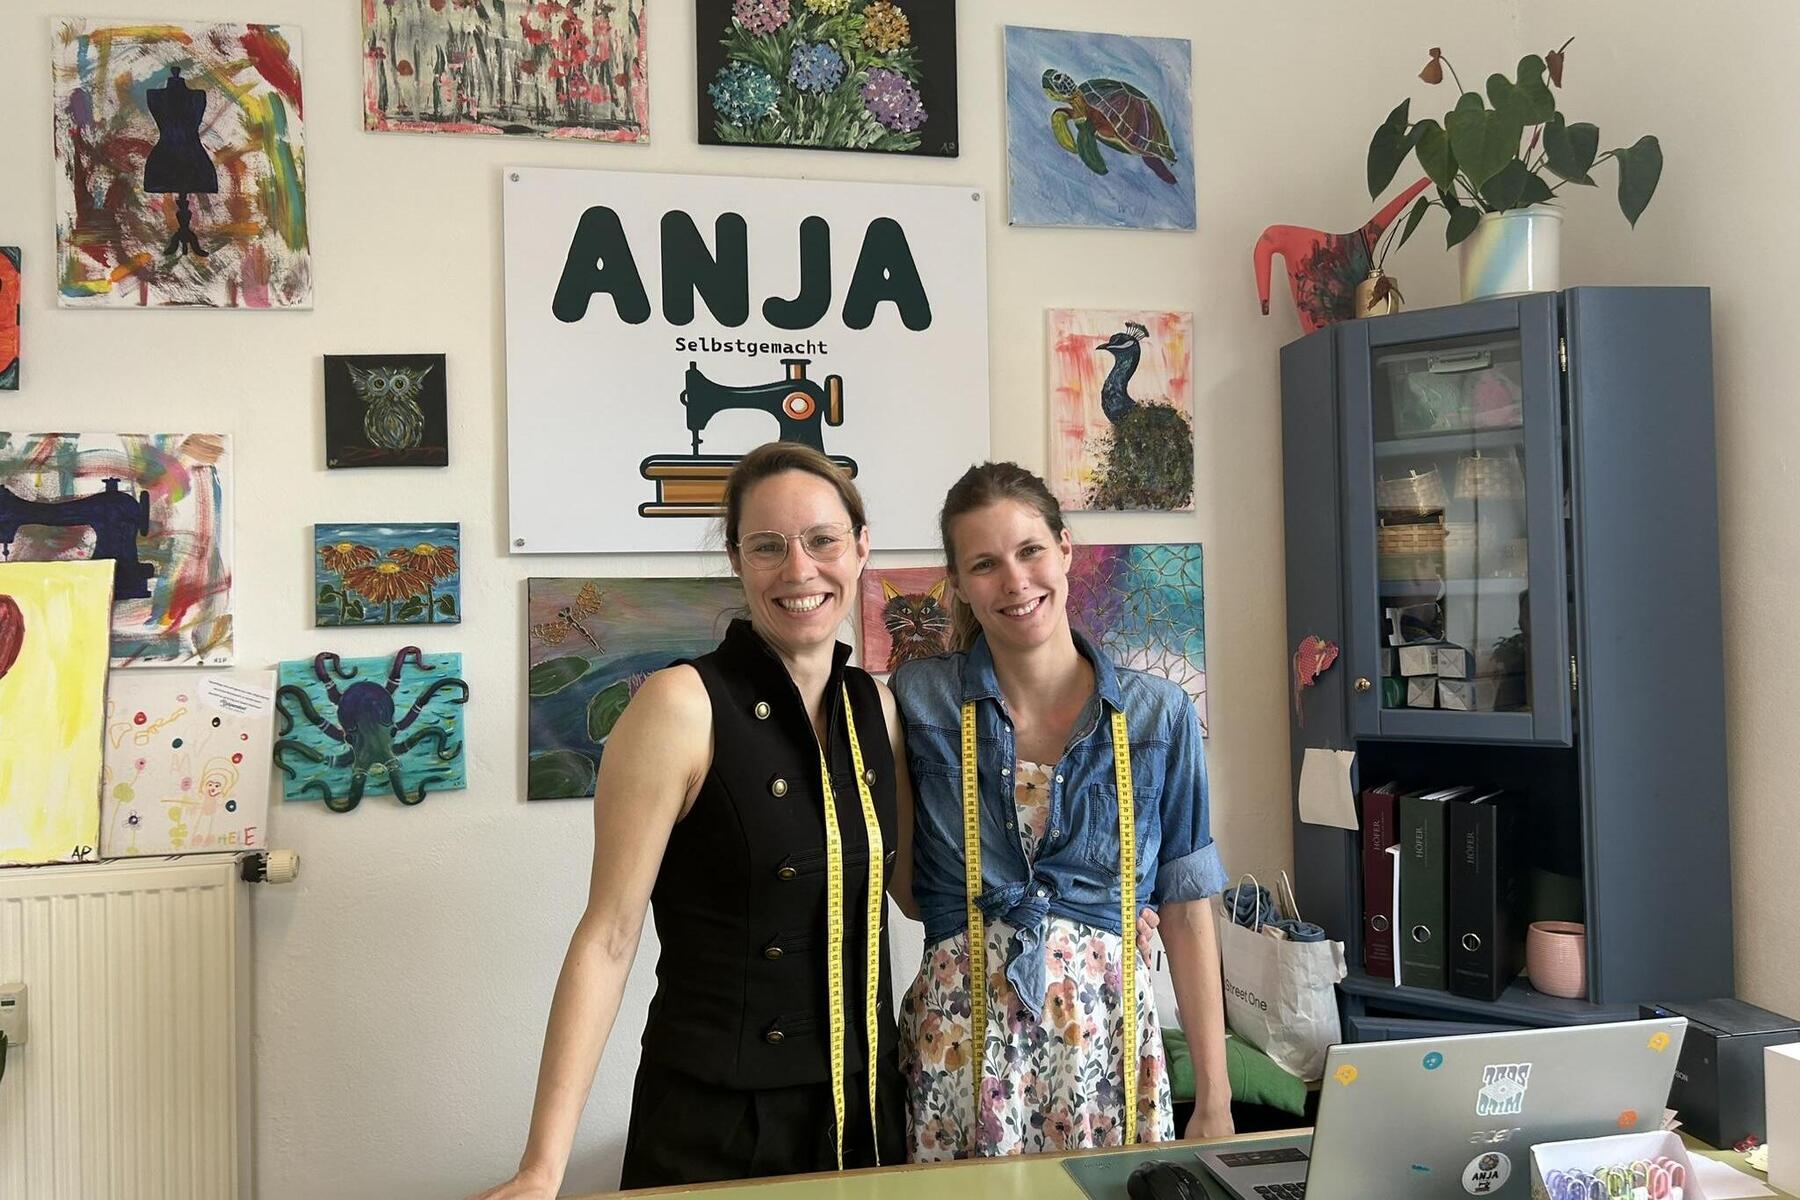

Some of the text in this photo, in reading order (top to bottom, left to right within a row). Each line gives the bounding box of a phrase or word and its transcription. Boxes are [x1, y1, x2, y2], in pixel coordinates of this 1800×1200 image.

[551, 205, 933, 332] ANJA
[674, 337, 828, 356] Selbstgemacht
[71, 845, 92, 861] AP
[1225, 978, 1268, 1011] Street One
[1472, 1171, 1499, 1181] ANJA
